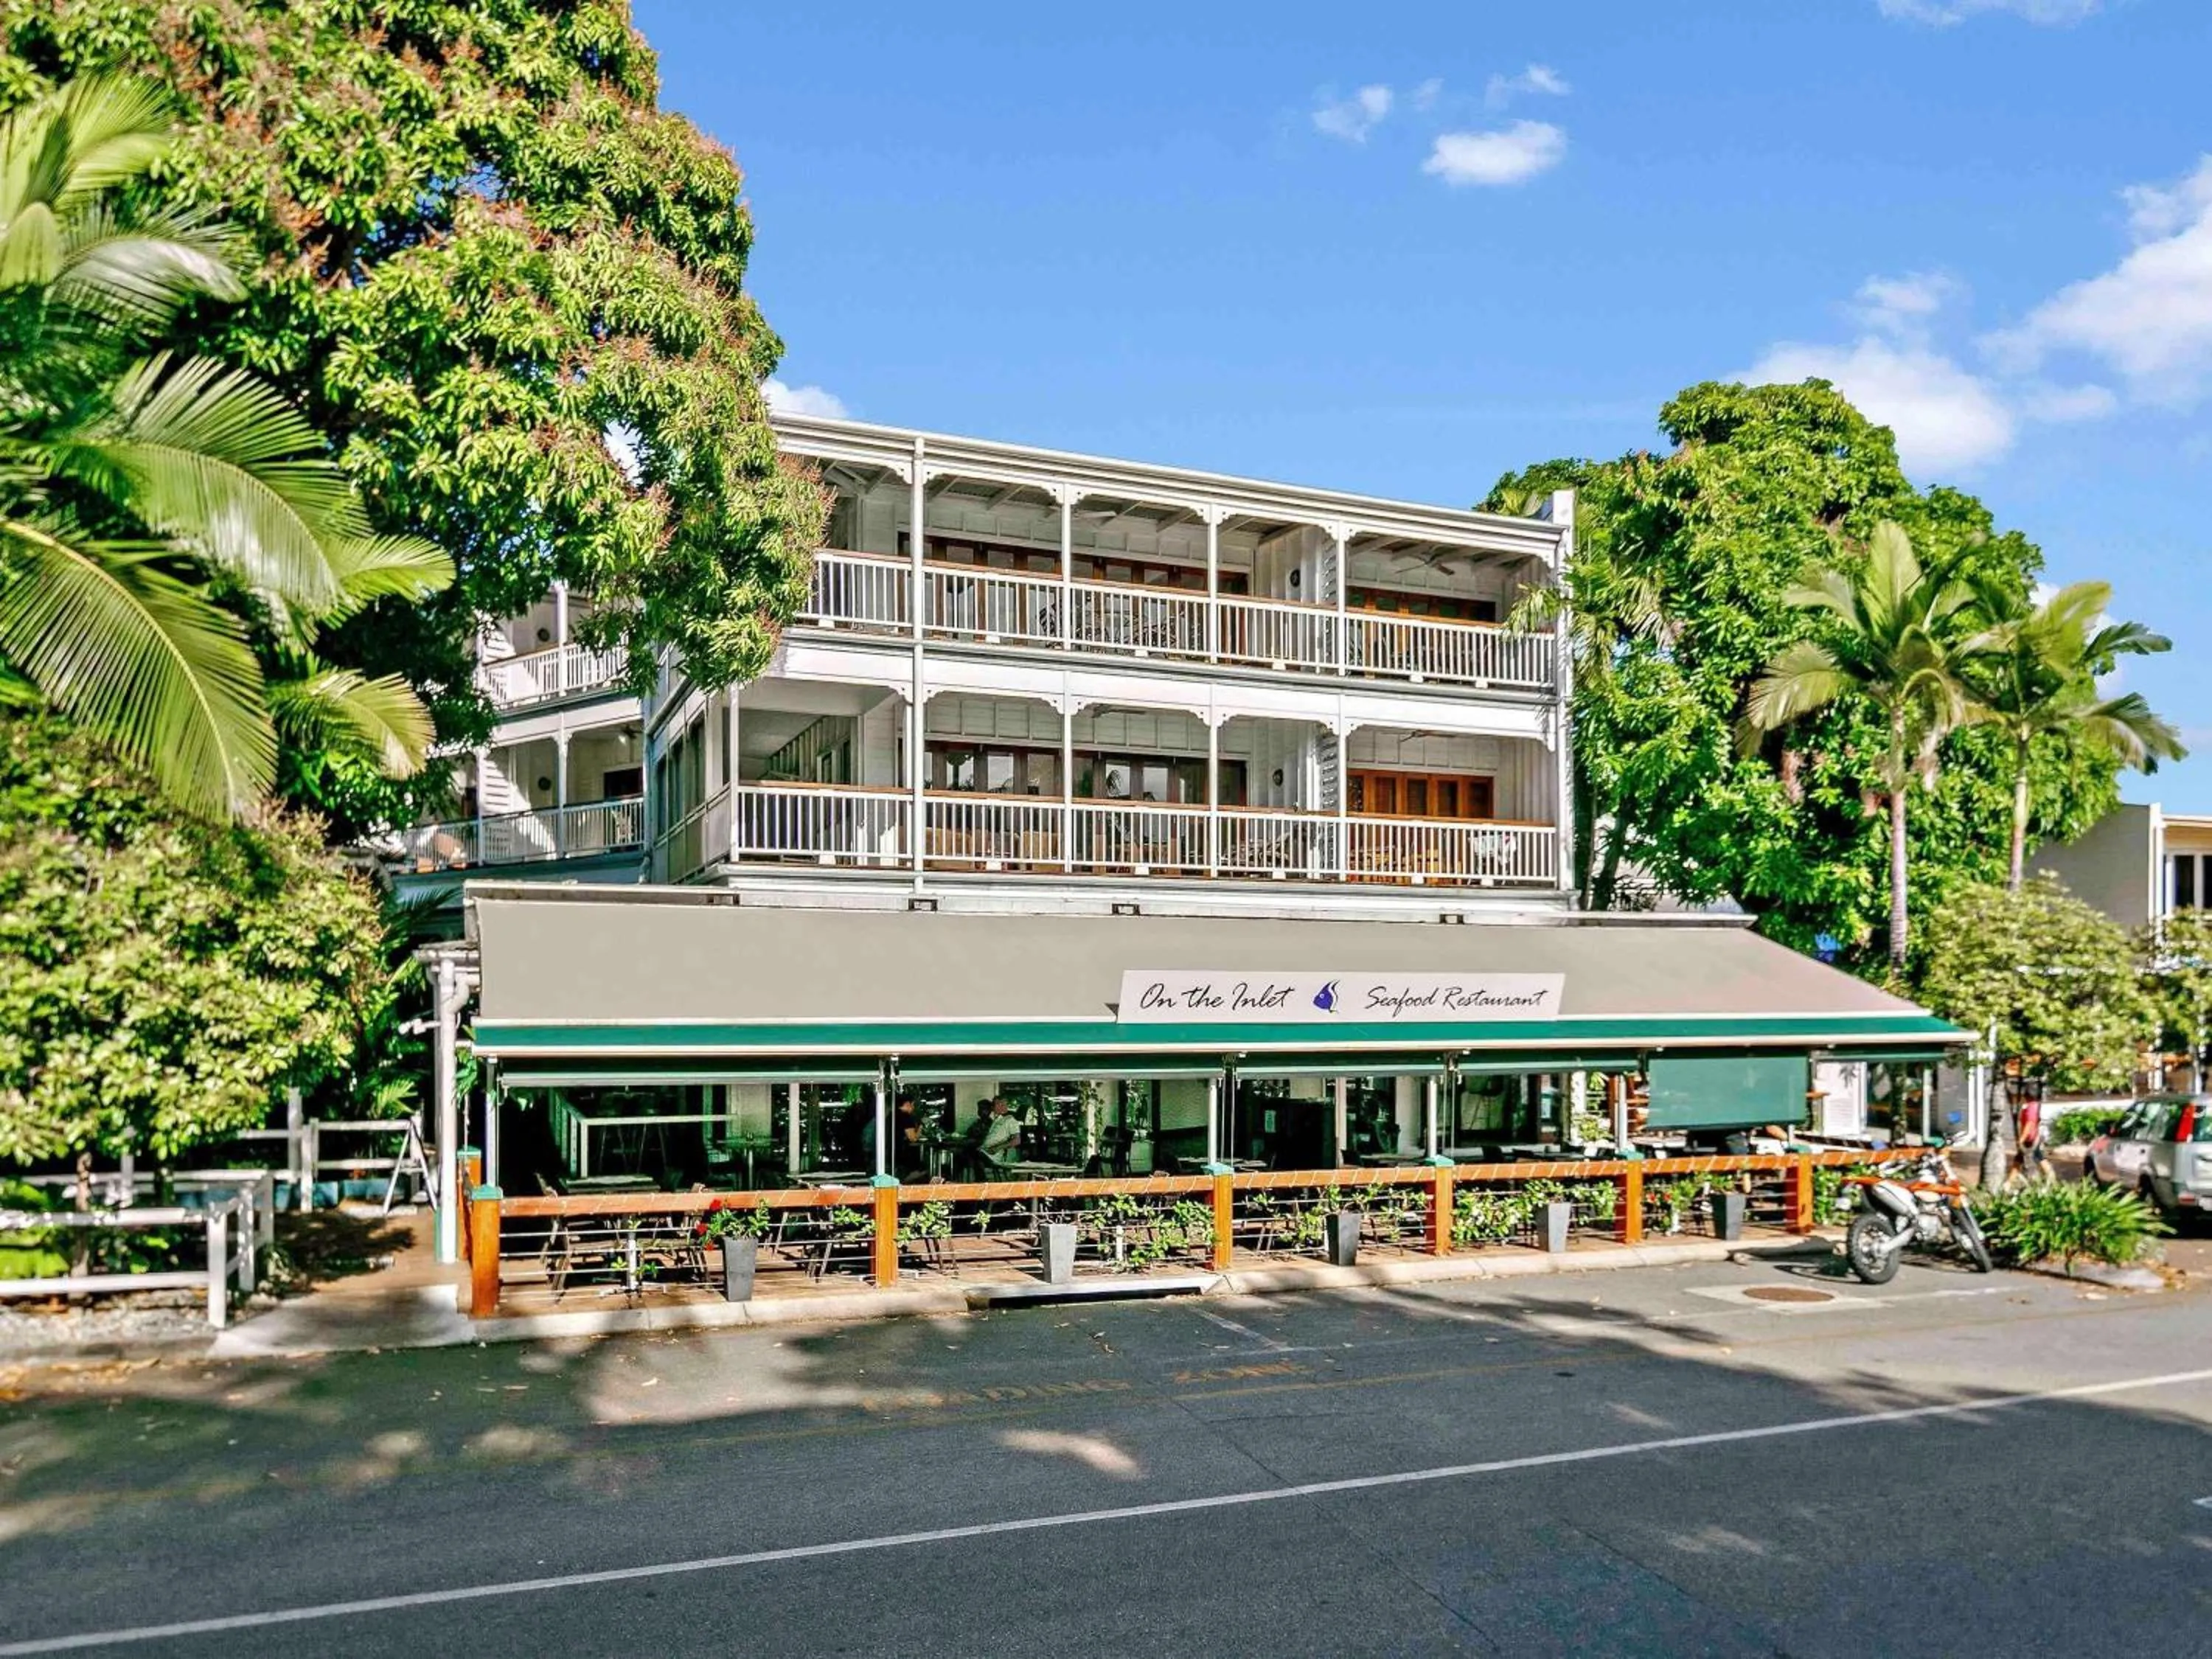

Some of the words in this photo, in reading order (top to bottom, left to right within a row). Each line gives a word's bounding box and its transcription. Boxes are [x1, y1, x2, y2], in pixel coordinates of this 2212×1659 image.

[1140, 982, 1177, 1010] On
[1181, 984, 1224, 1009] the
[1232, 982, 1295, 1011] Inlet
[1366, 986, 1439, 1017] Seafood
[1442, 987, 1547, 1011] Restaurant
